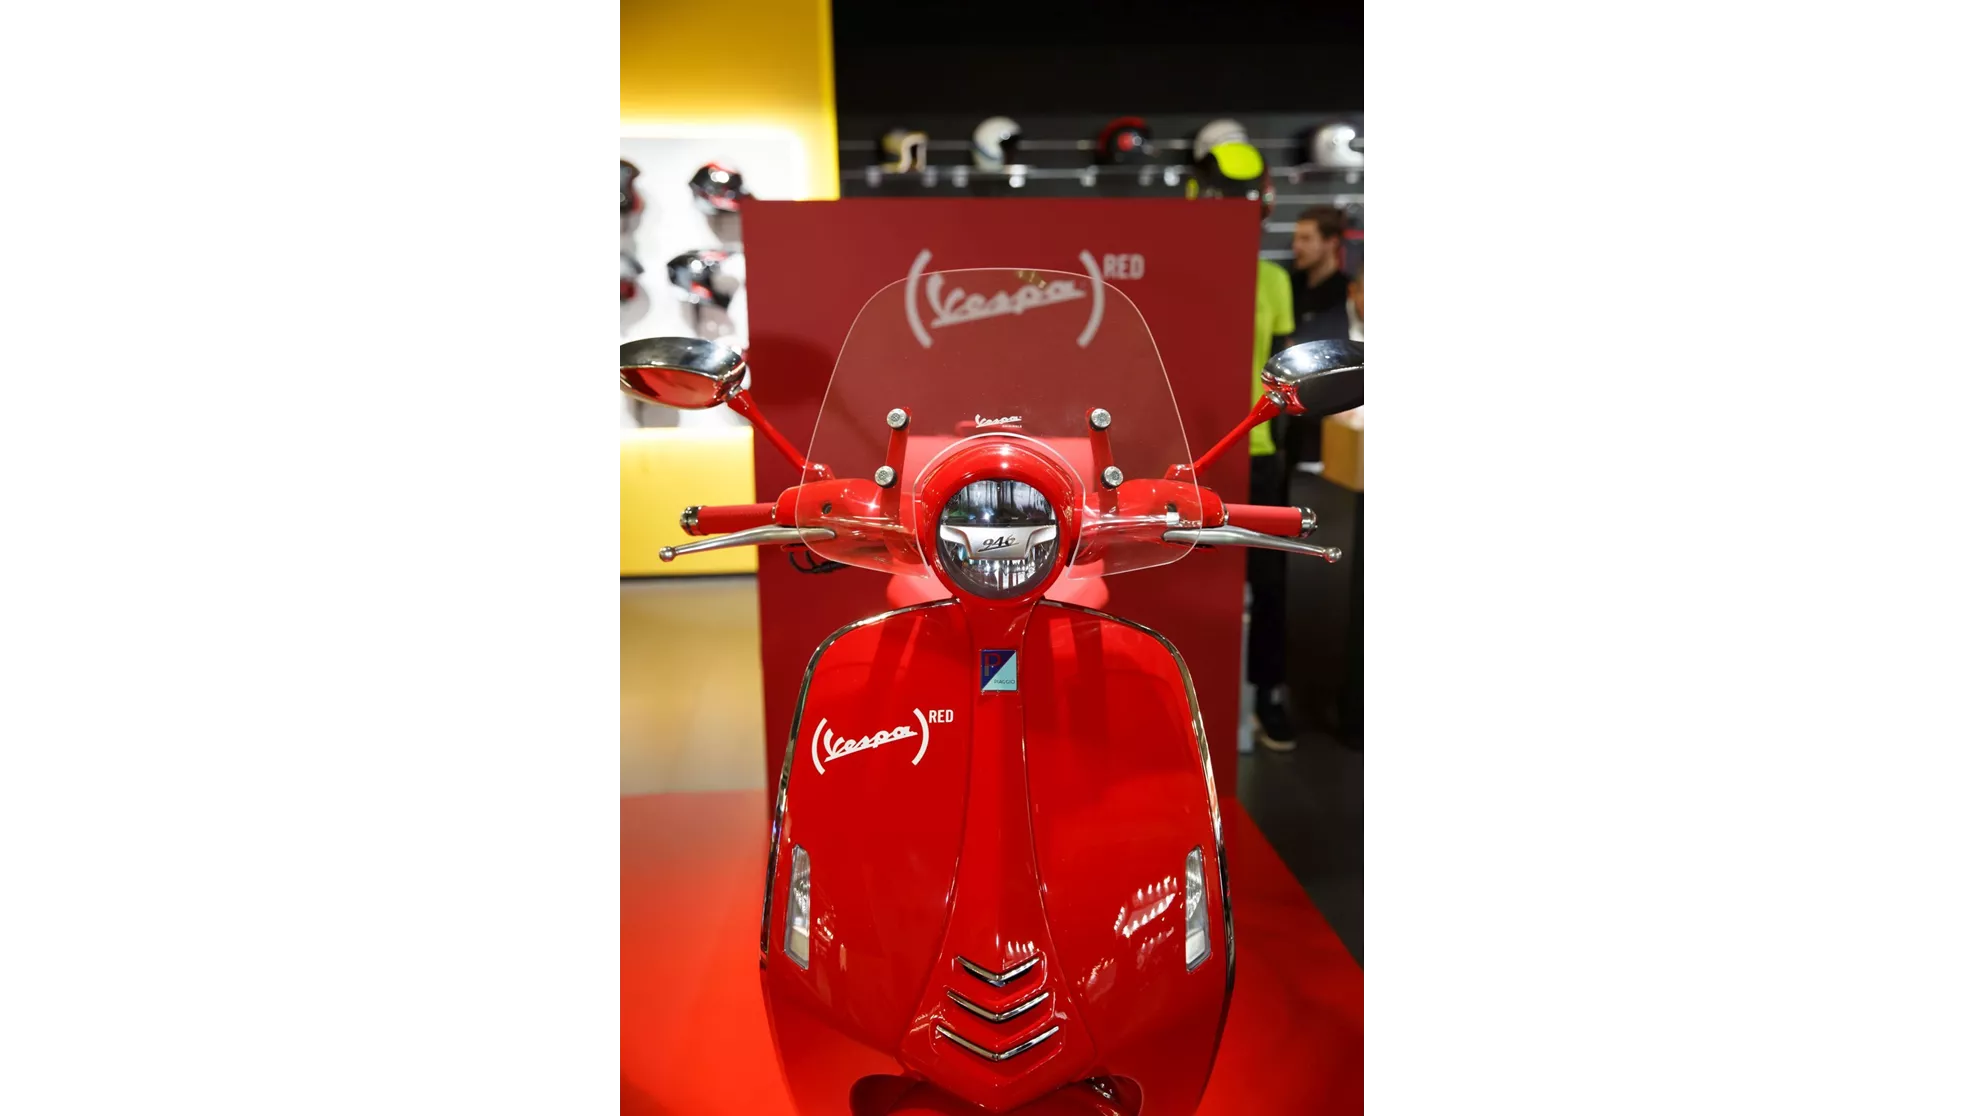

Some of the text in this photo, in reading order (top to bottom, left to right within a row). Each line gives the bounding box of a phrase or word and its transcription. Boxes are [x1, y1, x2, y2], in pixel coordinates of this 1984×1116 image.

[1103, 253, 1145, 280] RED
[975, 414, 1022, 428] Vespa
[978, 534, 1020, 552] 946
[929, 709, 954, 723] RED
